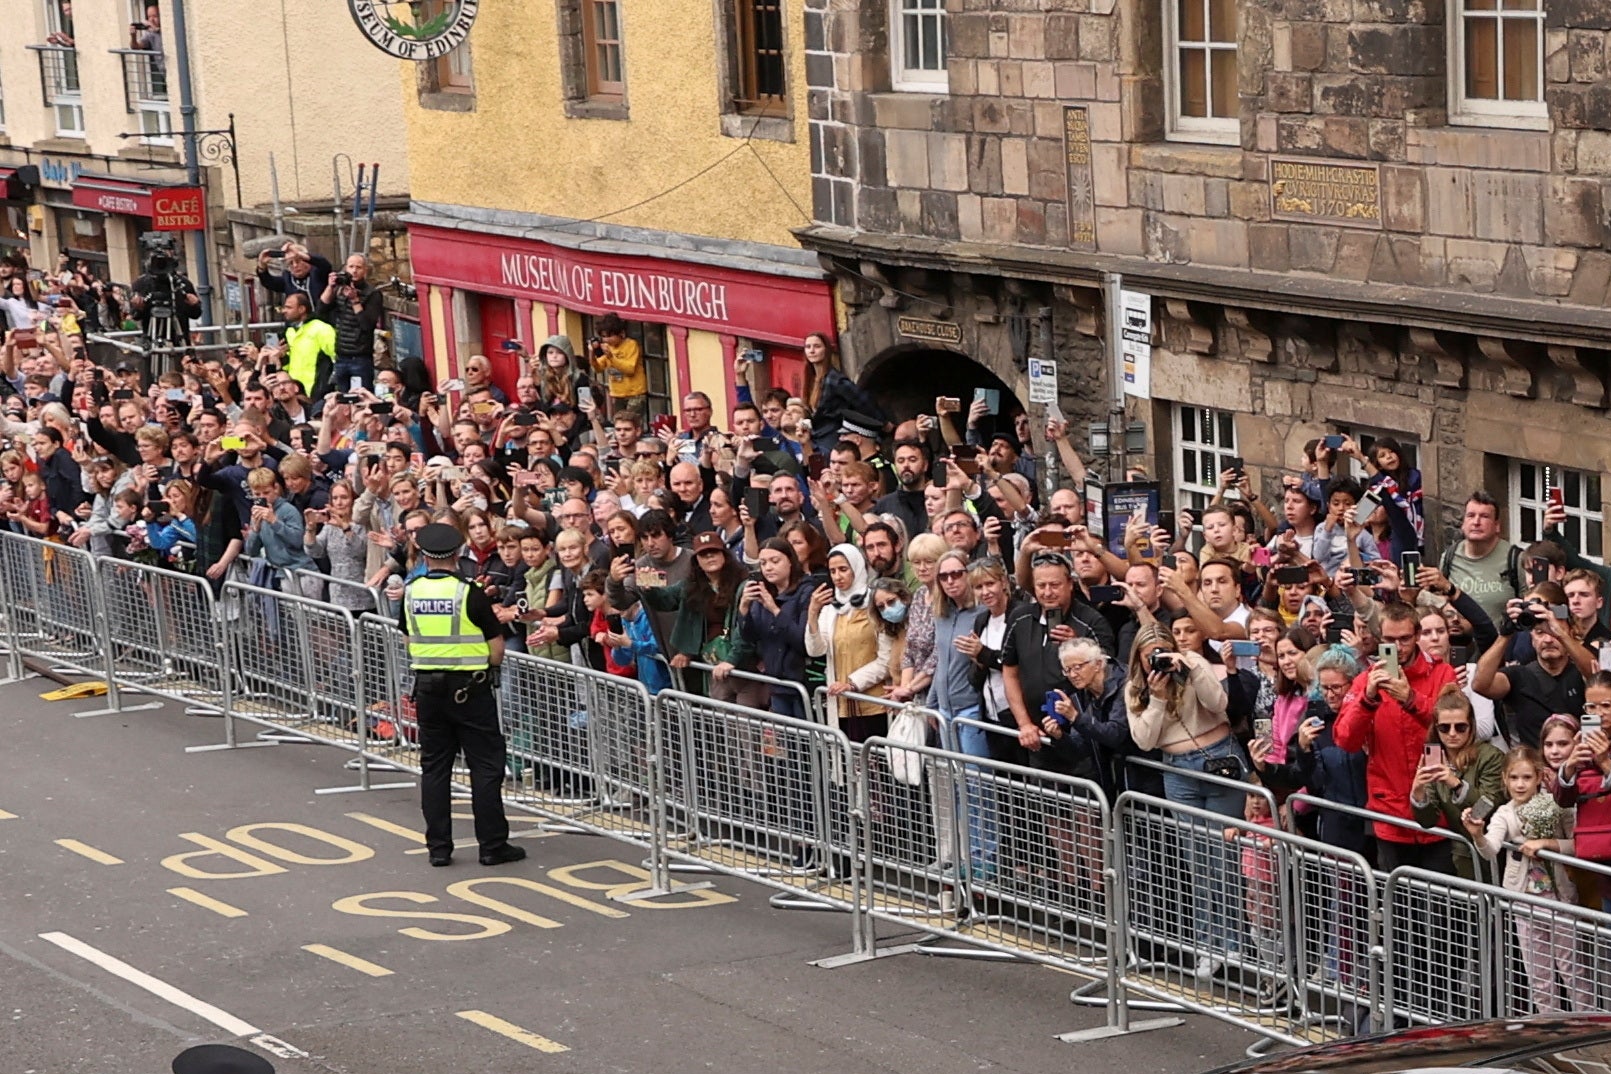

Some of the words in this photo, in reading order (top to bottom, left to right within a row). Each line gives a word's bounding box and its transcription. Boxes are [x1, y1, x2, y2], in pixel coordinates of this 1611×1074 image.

[398, 41, 420, 58] OF
[1312, 199, 1345, 217] 1570
[157, 215, 201, 226] BISTRO
[501, 252, 571, 298] MUSEUM
[571, 265, 593, 302] OF
[601, 270, 729, 321] EDINBURGH
[936, 325, 958, 338] CLOSE
[1460, 576, 1504, 594] Oliver
[412, 600, 453, 613] POLICE
[332, 860, 740, 942] BUS
